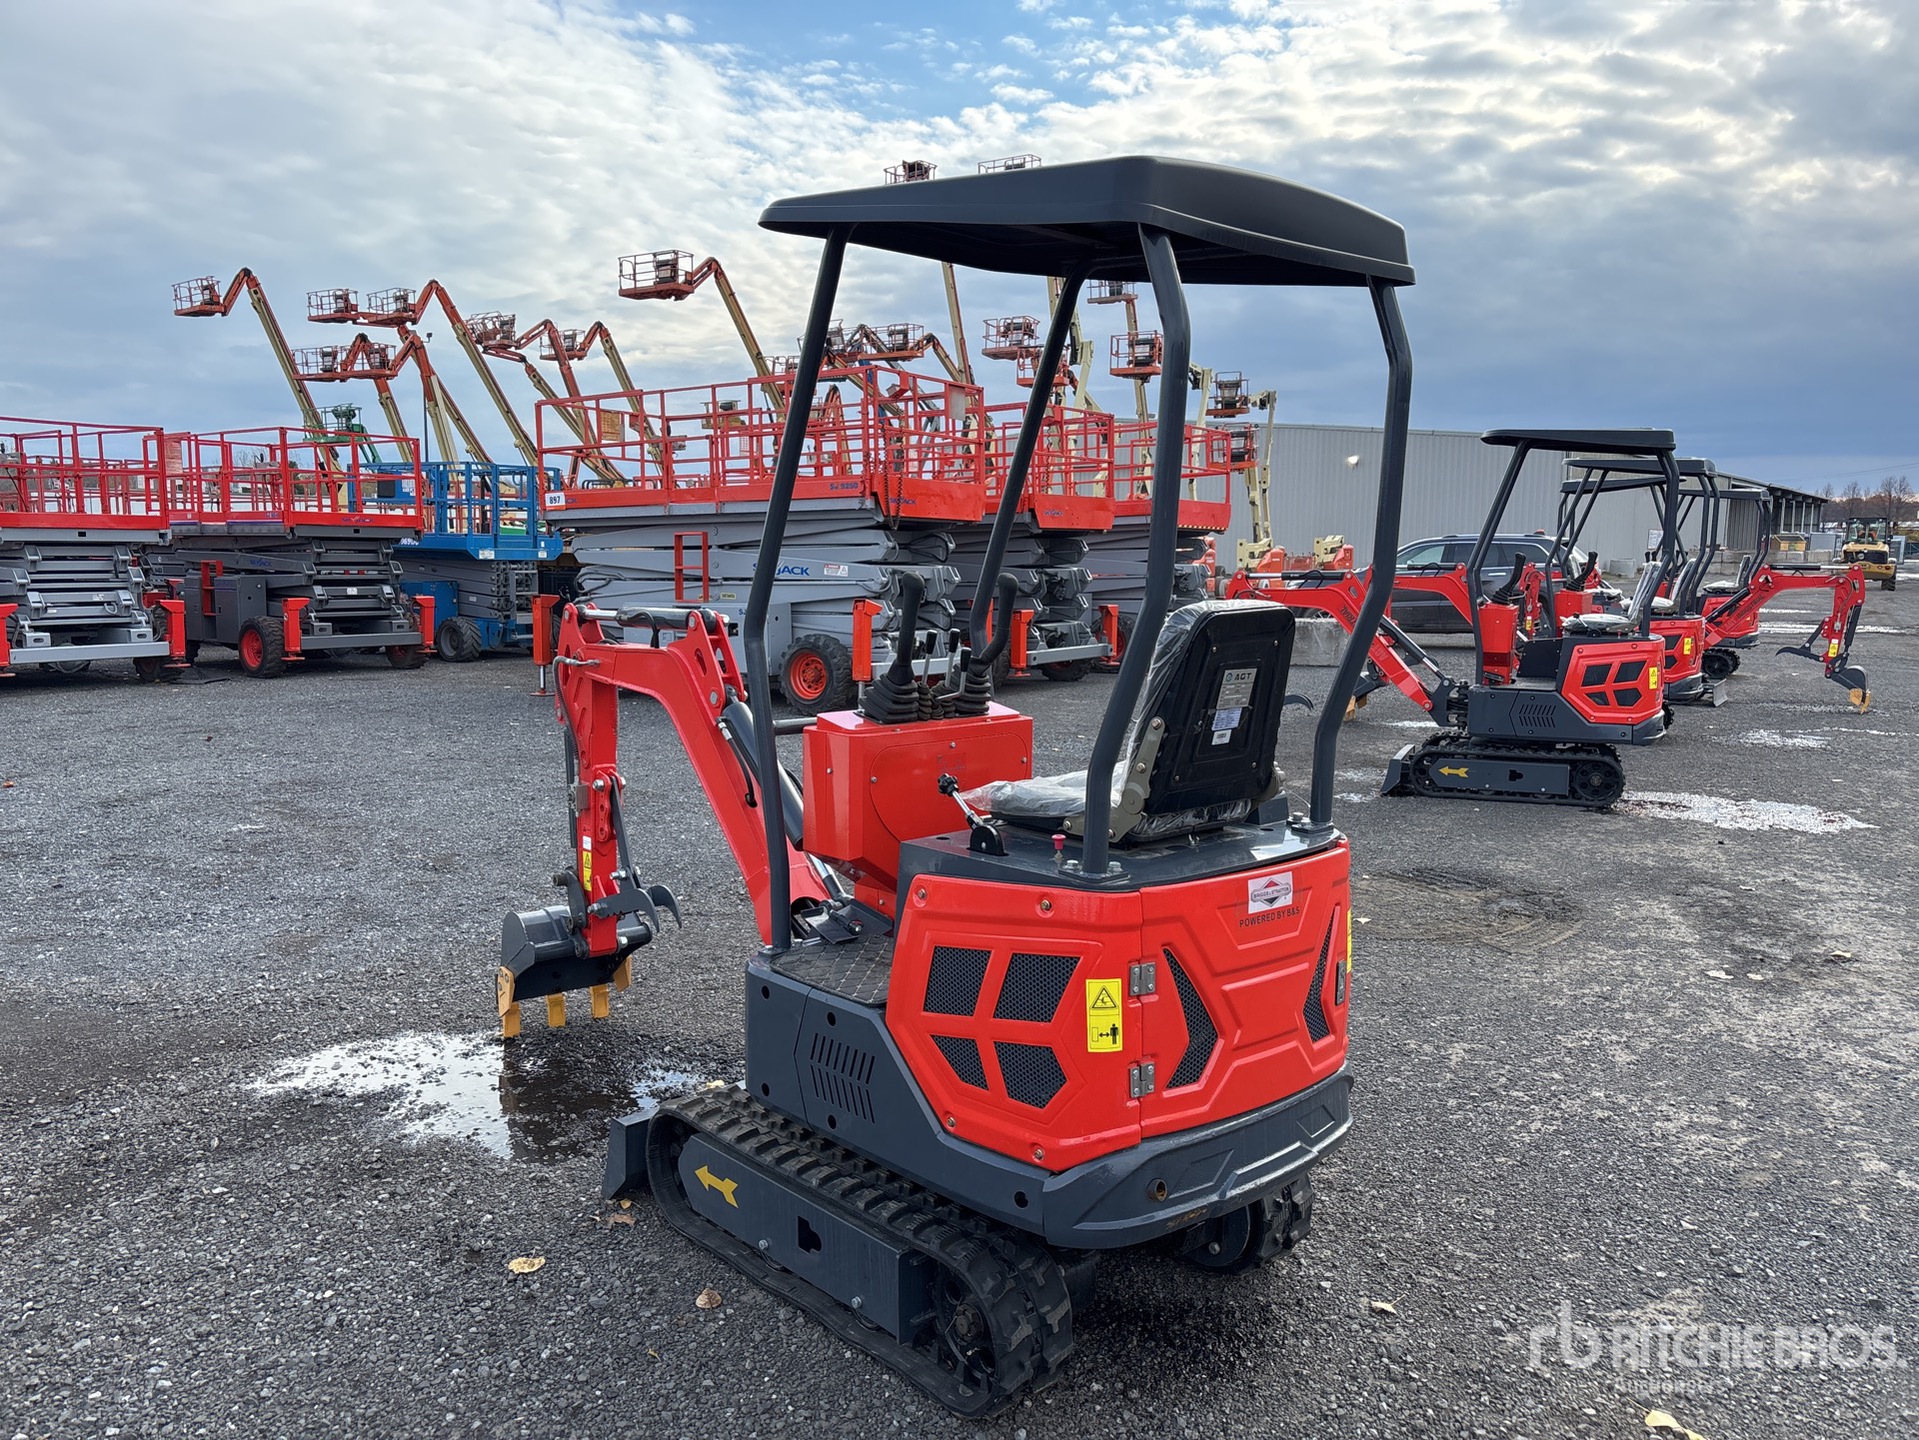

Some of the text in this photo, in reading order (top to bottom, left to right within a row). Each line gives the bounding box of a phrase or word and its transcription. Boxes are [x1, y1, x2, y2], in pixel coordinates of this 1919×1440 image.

[550, 496, 561, 504] 897
[1234, 672, 1252, 681] AGT
[1239, 906, 1300, 928] POWERED BY B&S
